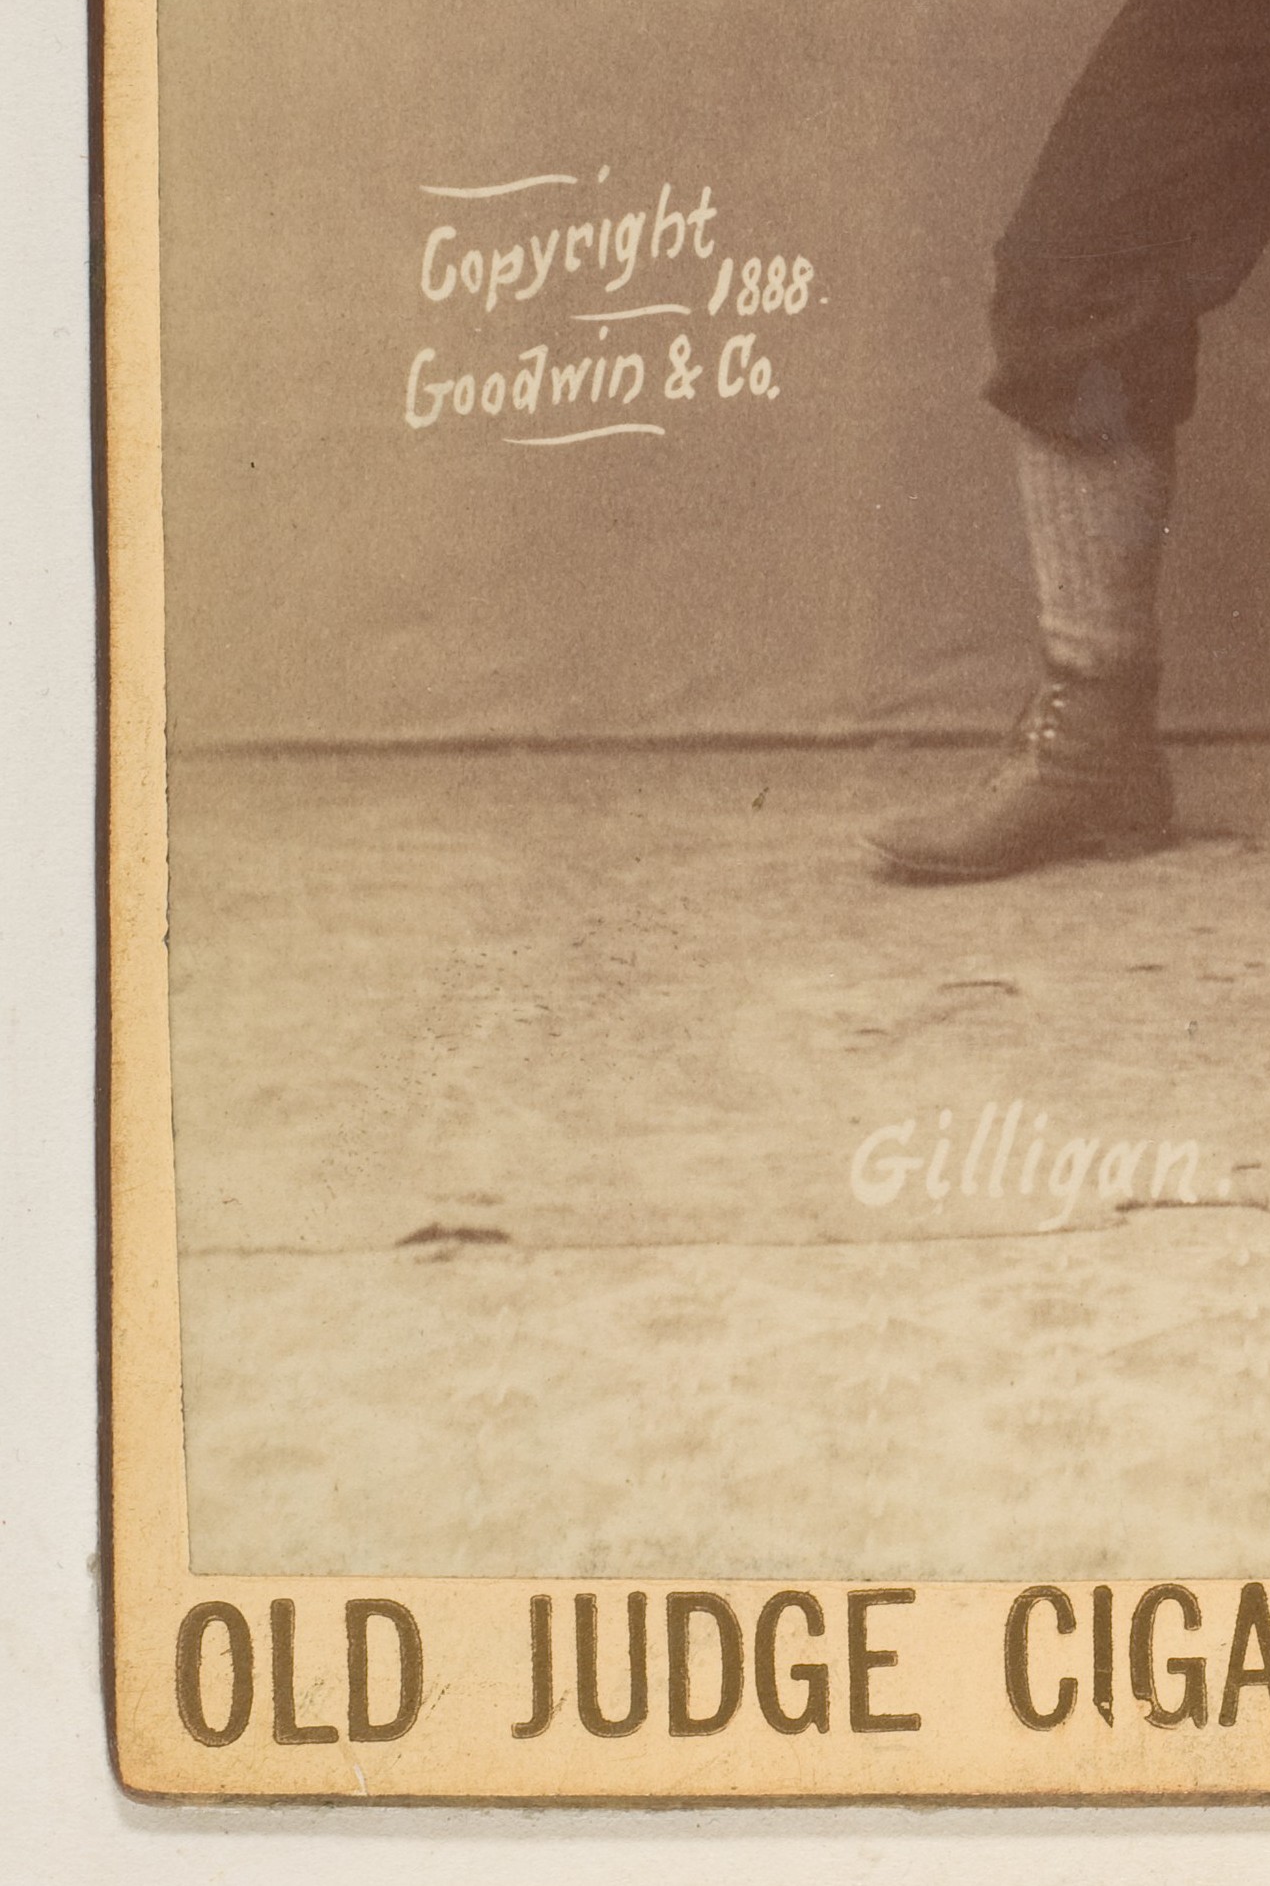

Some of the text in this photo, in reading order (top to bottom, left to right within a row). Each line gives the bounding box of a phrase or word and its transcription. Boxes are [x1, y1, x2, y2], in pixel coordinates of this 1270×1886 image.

[420, 164, 718, 313] Copyright
[404, 325, 781, 429] Goodwin & Co.
[174, 1598, 425, 1748] OLD
[510, 1587, 922, 1739] JUDGE
